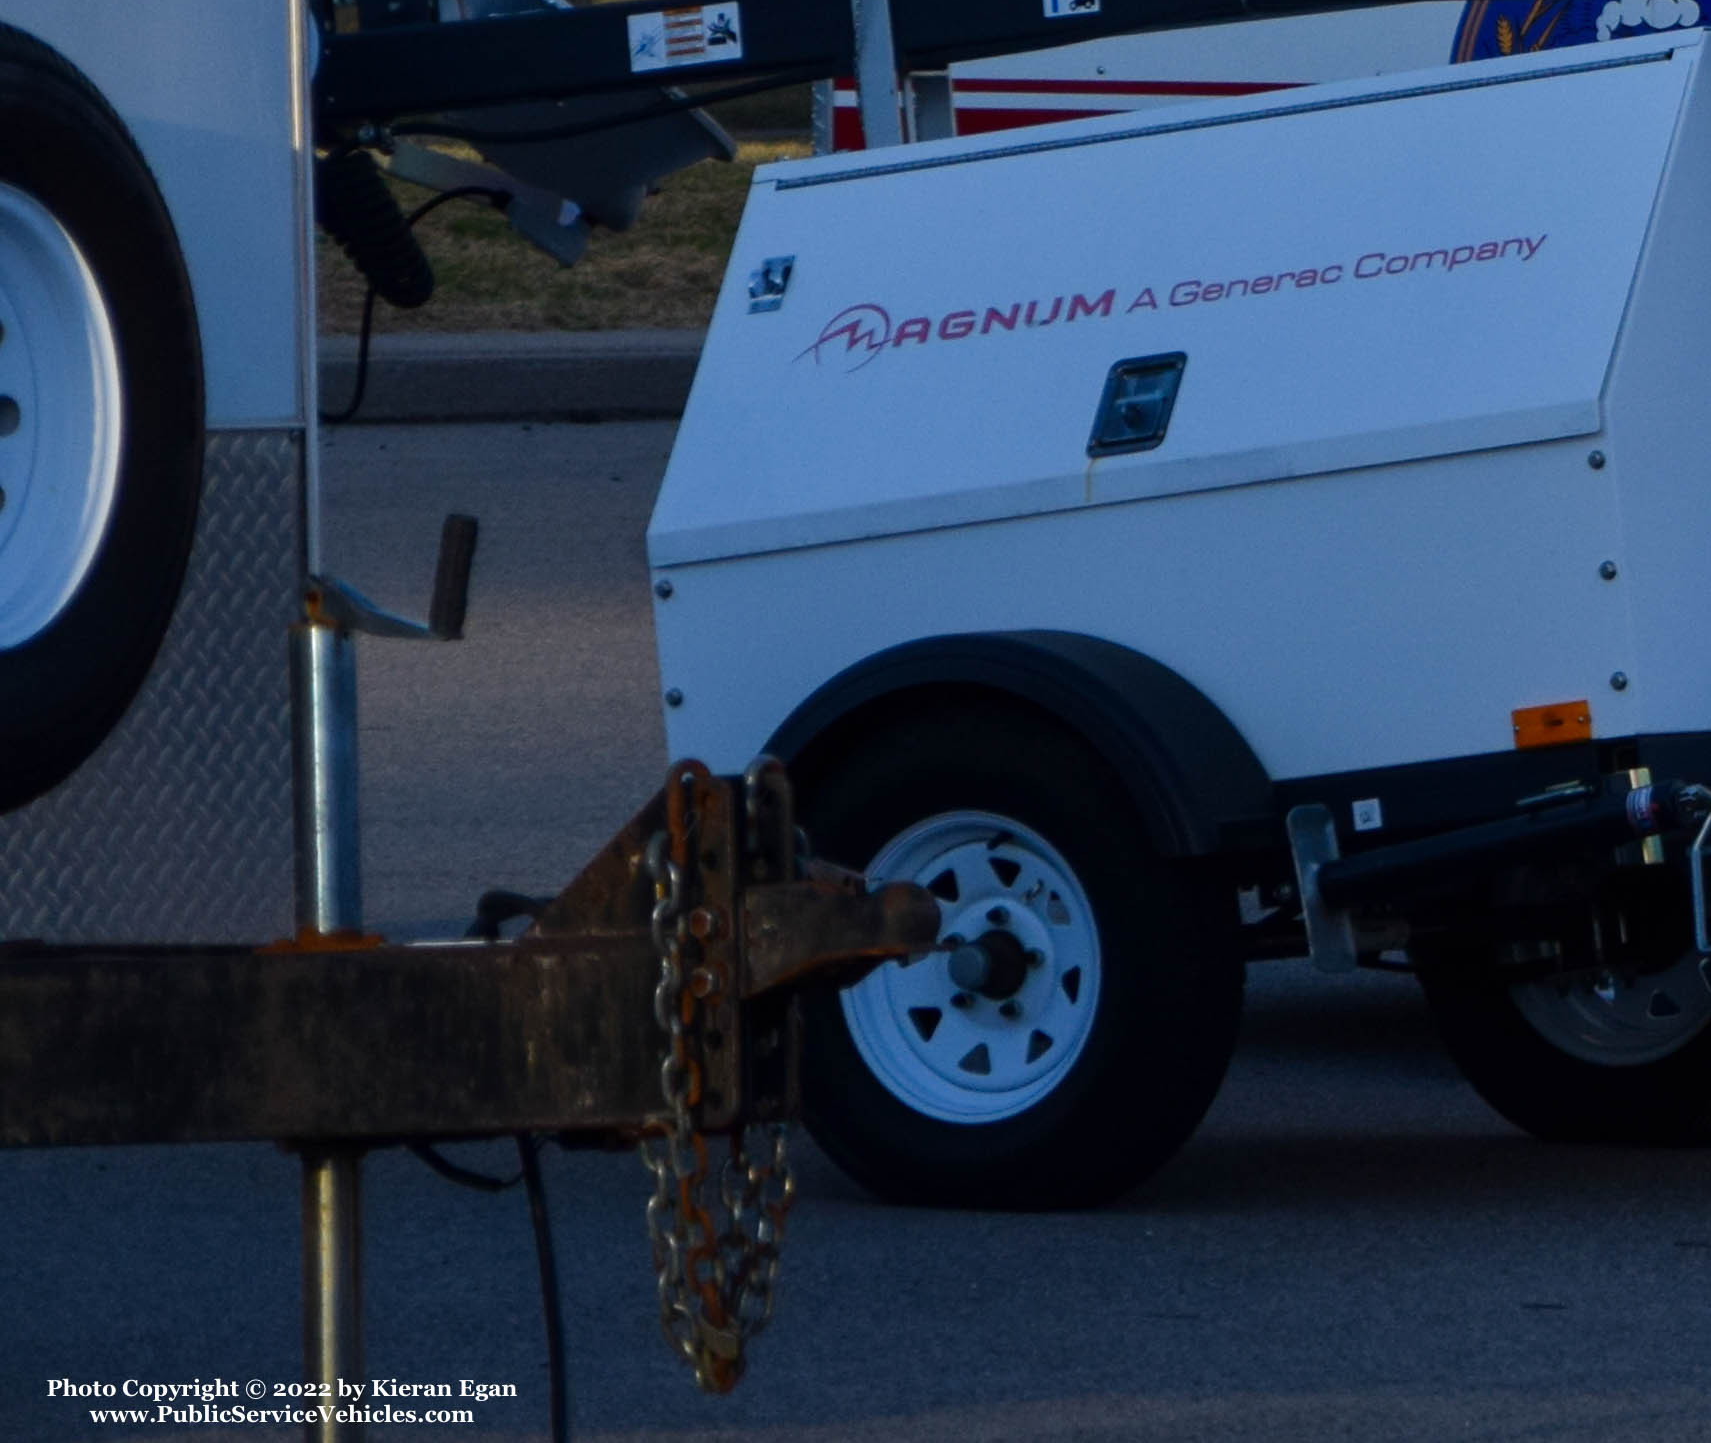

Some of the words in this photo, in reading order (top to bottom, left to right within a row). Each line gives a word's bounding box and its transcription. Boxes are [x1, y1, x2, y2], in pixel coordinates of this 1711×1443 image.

[1127, 287, 1158, 314] A
[1170, 264, 1343, 308] Generac
[1353, 234, 1549, 281] Company
